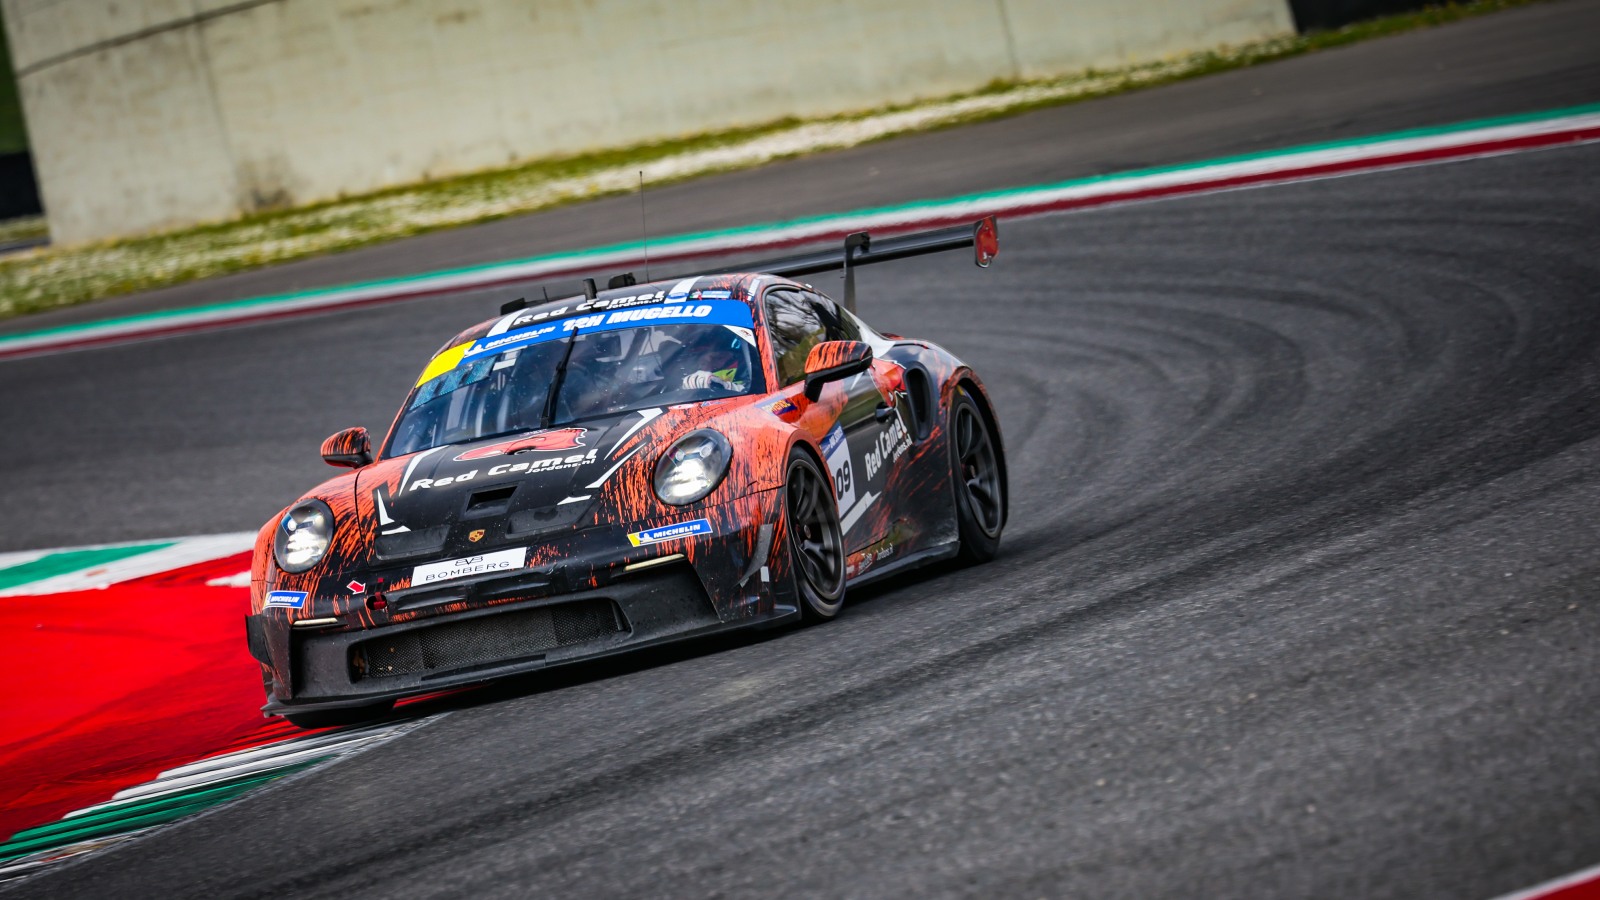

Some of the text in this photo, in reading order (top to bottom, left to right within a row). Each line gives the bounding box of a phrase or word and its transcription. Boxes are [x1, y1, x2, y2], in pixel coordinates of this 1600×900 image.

[513, 306, 569, 325] Red
[576, 291, 665, 311] Camel
[563, 305, 712, 331] 12H MUGELLO
[485, 326, 556, 348] MICHELIN
[865, 409, 907, 481] Red Camel
[409, 449, 599, 491] Red Camel
[525, 459, 595, 474] Jordans.nl
[653, 524, 701, 538] MICHELIN
[426, 561, 510, 581] BOMBERG
